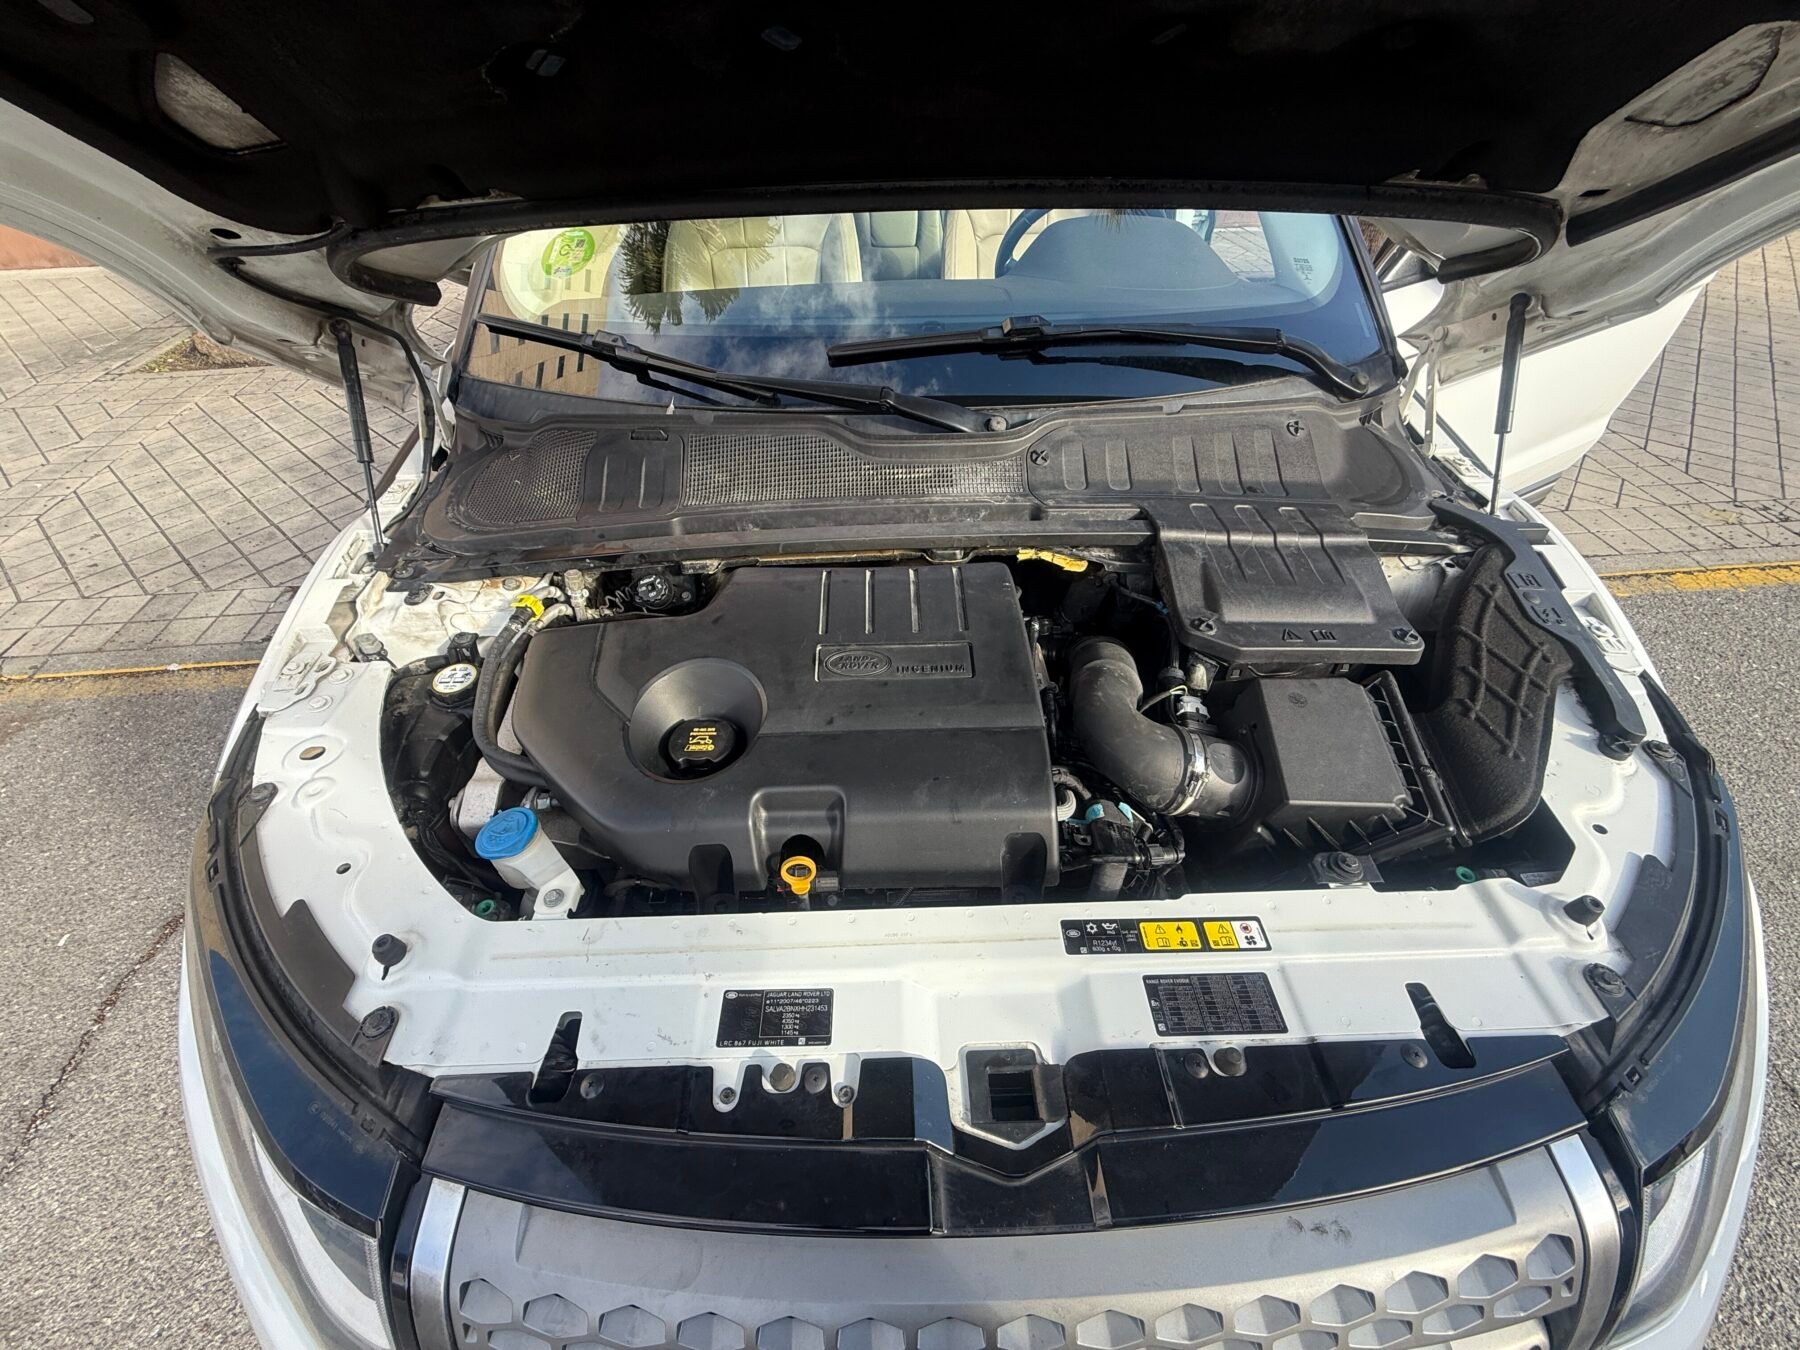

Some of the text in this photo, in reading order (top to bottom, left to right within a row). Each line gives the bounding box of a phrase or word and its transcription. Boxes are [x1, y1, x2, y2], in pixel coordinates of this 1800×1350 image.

[840, 655, 870, 663] LAND
[840, 662, 879, 670] ROVER
[896, 664, 966, 674] INGENIUM
